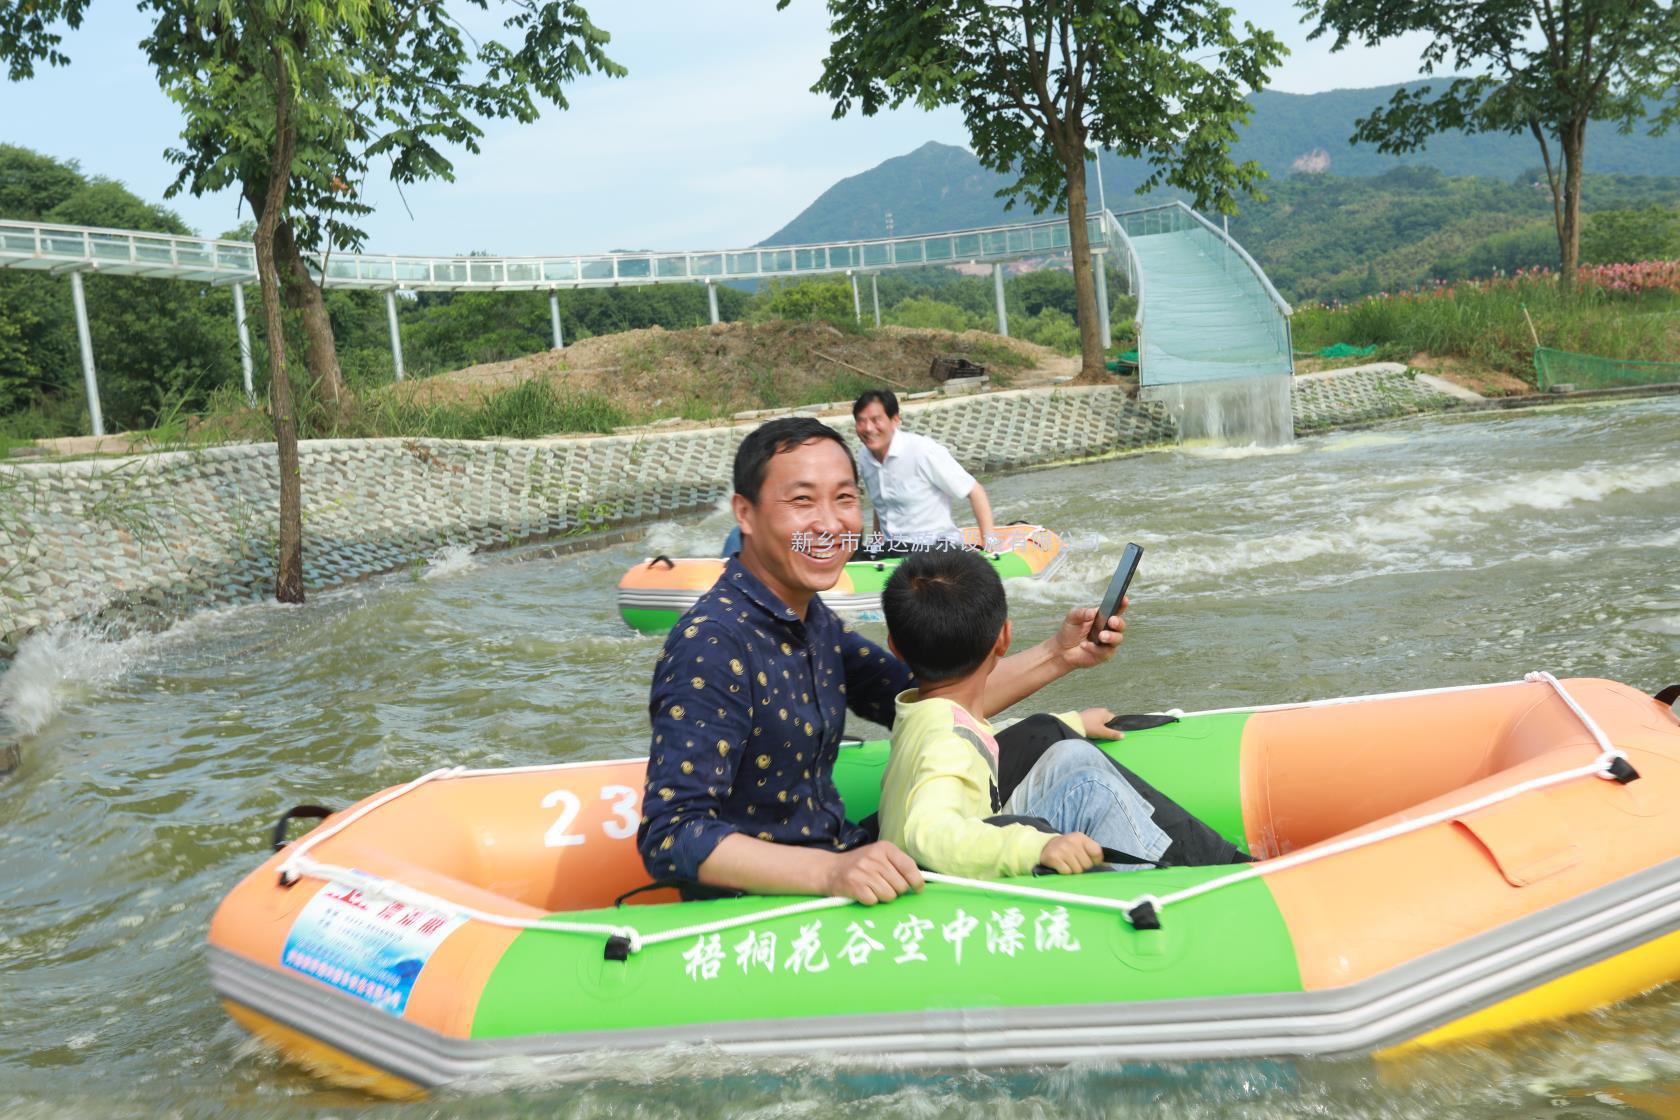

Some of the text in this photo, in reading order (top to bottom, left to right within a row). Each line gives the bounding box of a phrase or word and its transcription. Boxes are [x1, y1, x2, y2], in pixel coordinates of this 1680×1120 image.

[541, 785, 641, 847] 23
[682, 906, 1081, 982] 梧桐花谷空中漂流
